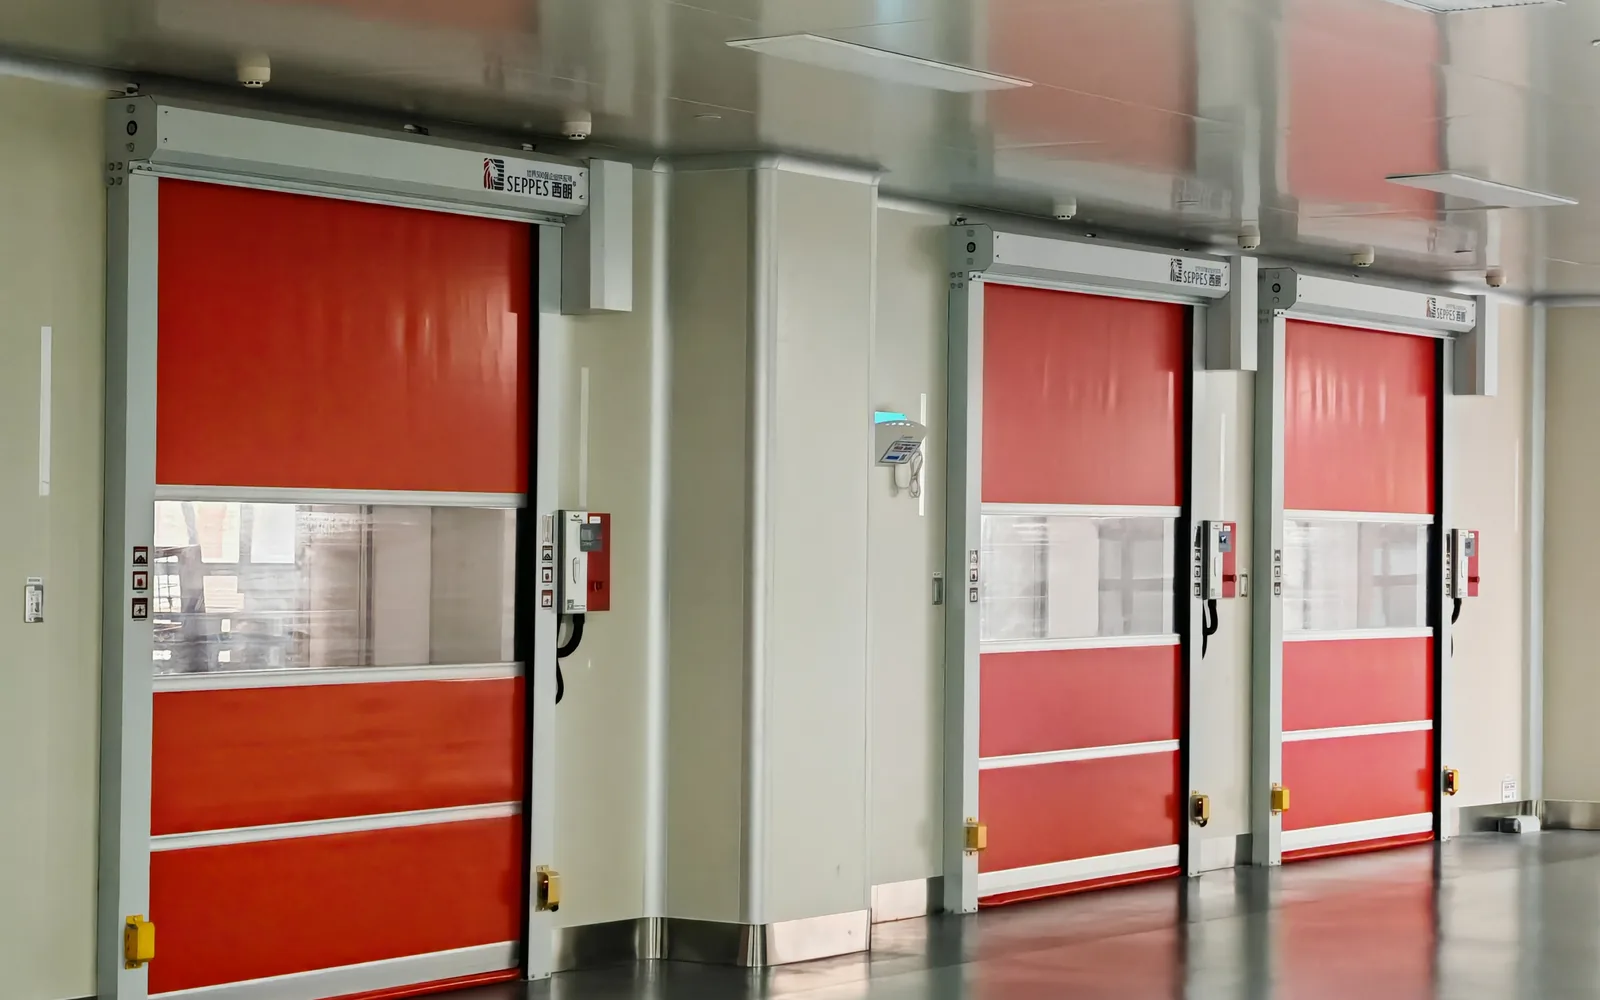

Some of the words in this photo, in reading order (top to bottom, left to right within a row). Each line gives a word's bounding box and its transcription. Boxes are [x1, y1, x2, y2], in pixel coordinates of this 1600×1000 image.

[506, 175, 549, 197] SEPPES
[551, 181, 573, 200] 西朗
[1183, 270, 1208, 286] SEPPES
